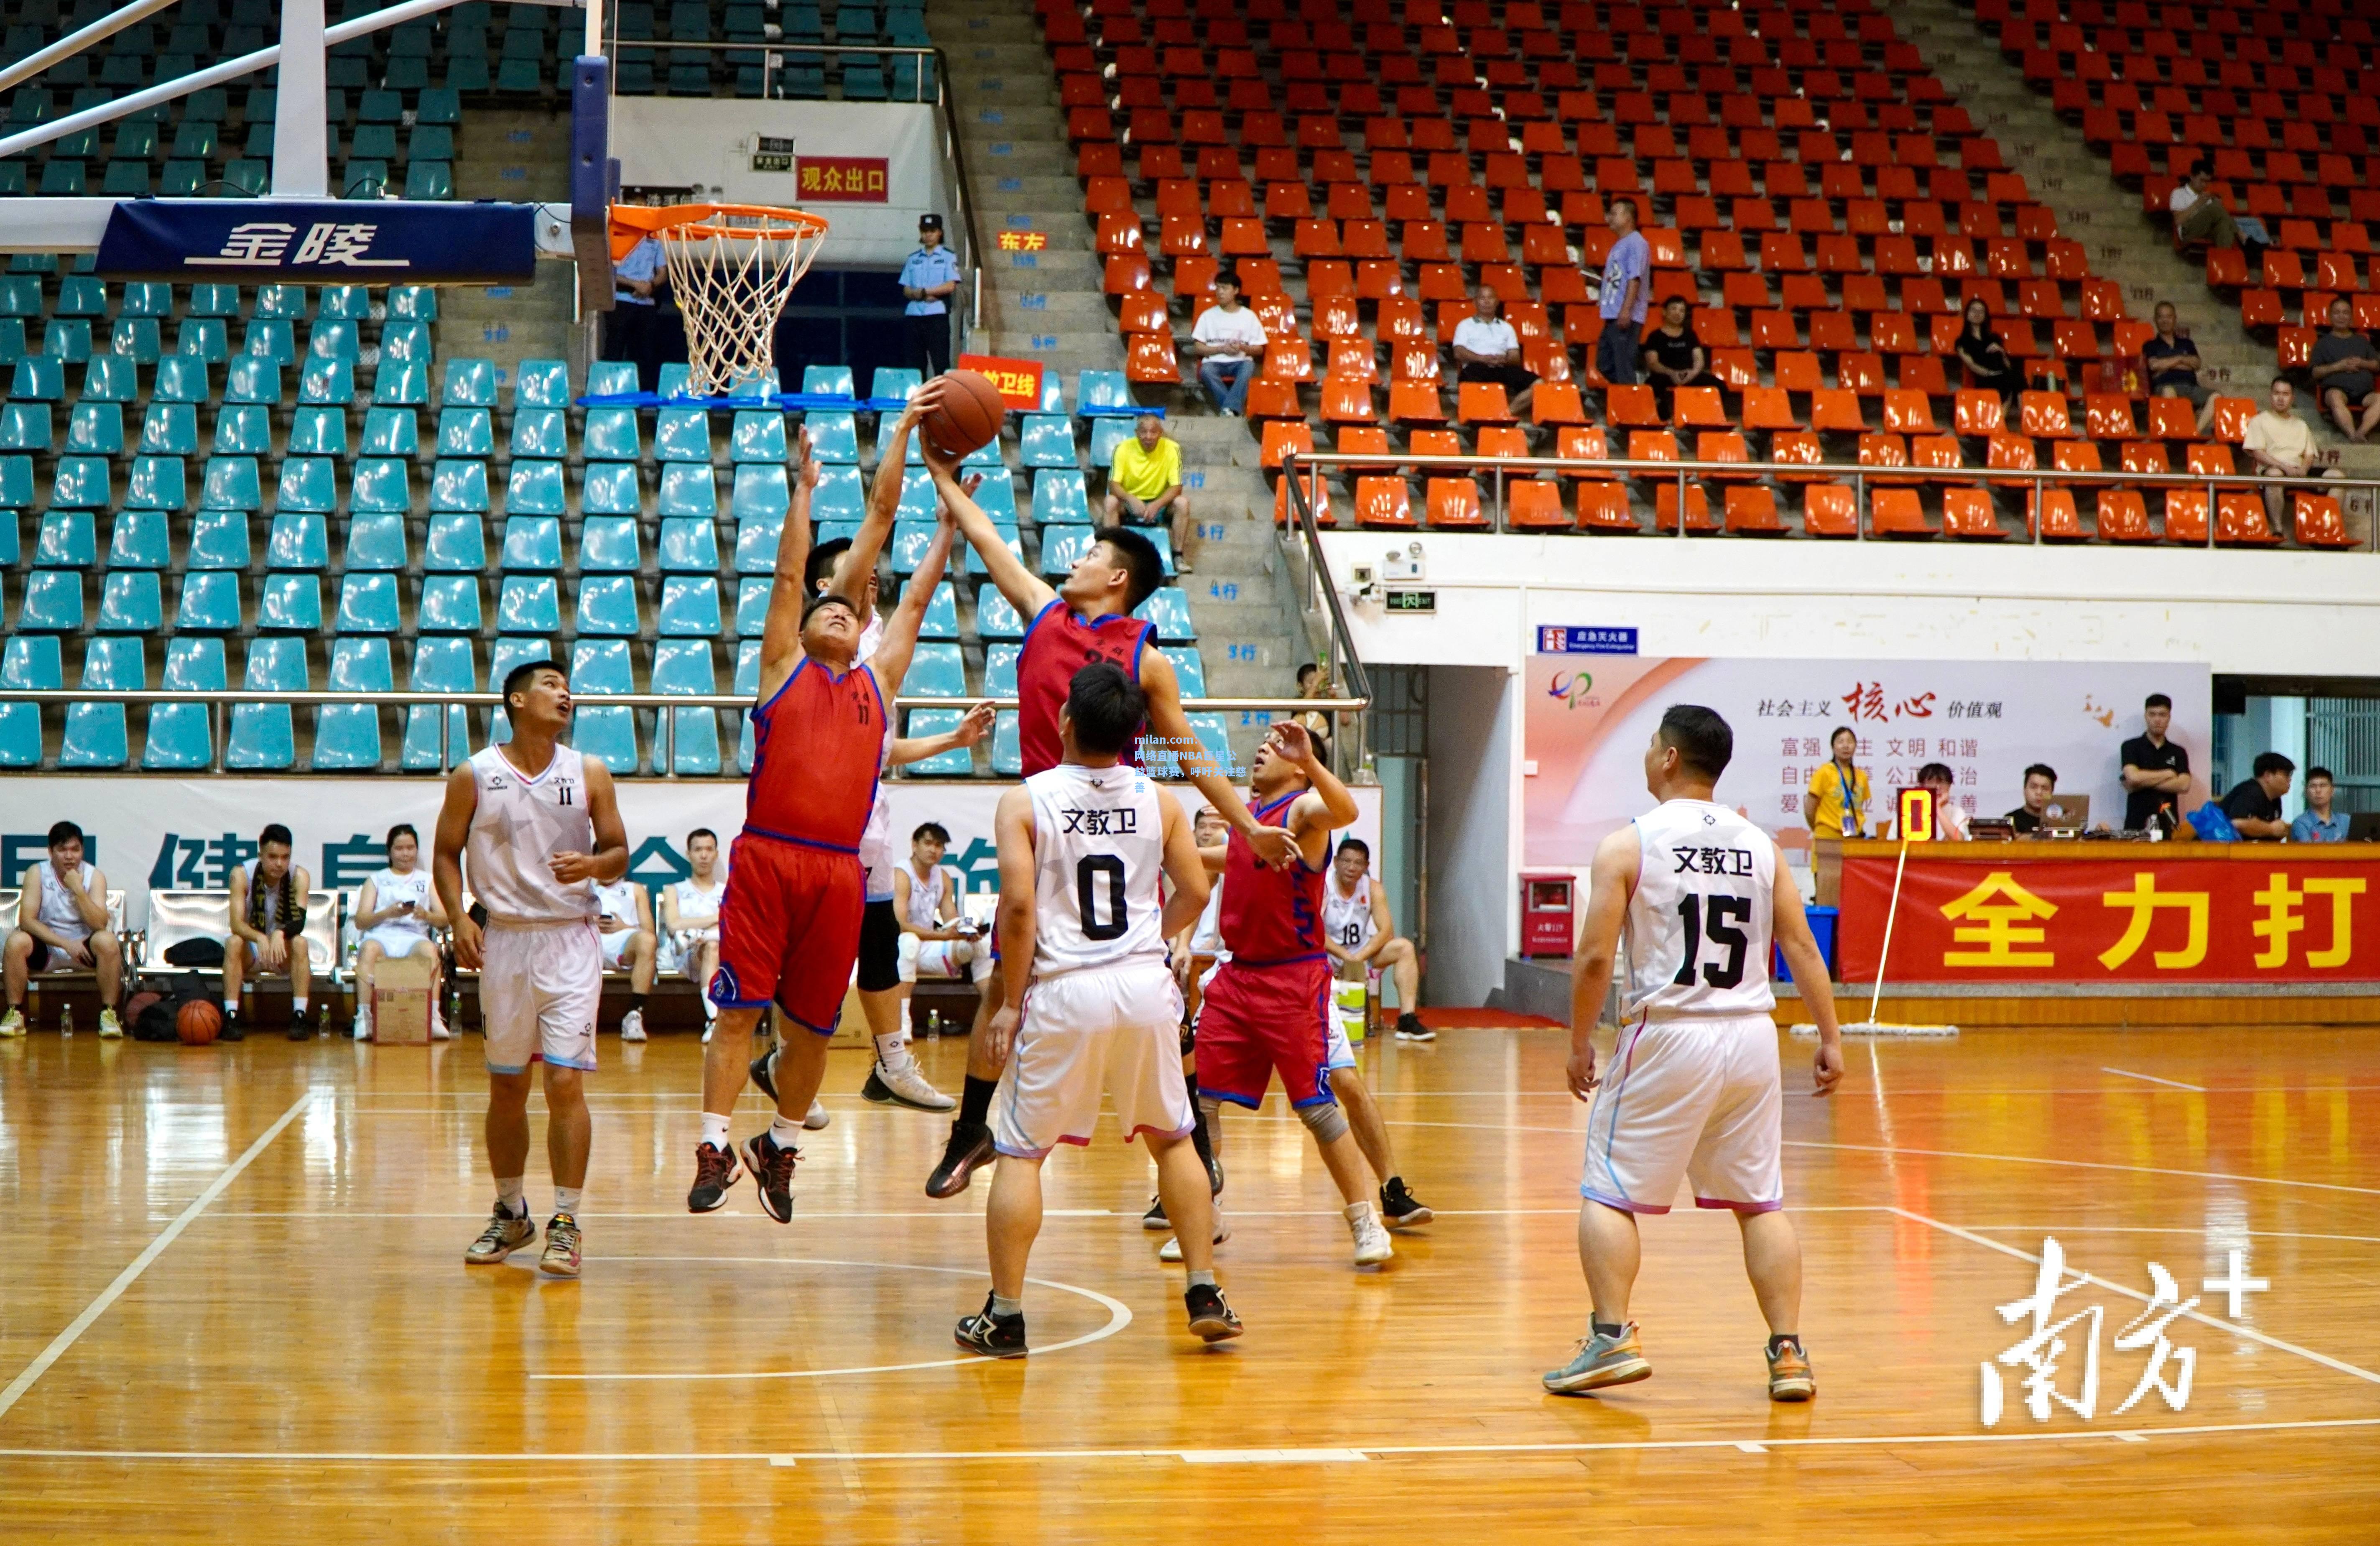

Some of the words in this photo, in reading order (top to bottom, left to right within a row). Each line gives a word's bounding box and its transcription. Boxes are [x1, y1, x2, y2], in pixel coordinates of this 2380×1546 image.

[802, 166, 884, 193] 观众出口
[184, 223, 410, 266] 金陵
[971, 368, 1035, 397] 卫线
[1211, 583, 1238, 600] 4行
[1228, 644, 1256, 661] 3行
[858, 704, 869, 726] 11
[1757, 699, 1832, 718] 社会主义
[1842, 681, 1936, 723] 核心
[1947, 700, 2003, 719] 价值观
[1781, 737, 1821, 757] 富强
[1886, 737, 1926, 757] 文明
[1938, 738, 1978, 758] 和谐
[559, 787, 572, 806] 11
[1061, 809, 1136, 835] 文教卫
[1901, 790, 1931, 841] 0
[1672, 846, 1752, 877] 文教卫
[1077, 854, 1128, 941] 0
[1342, 924, 1360, 946] 18
[1940, 871, 2367, 971] 全力打
[1673, 893, 1752, 990] 15
